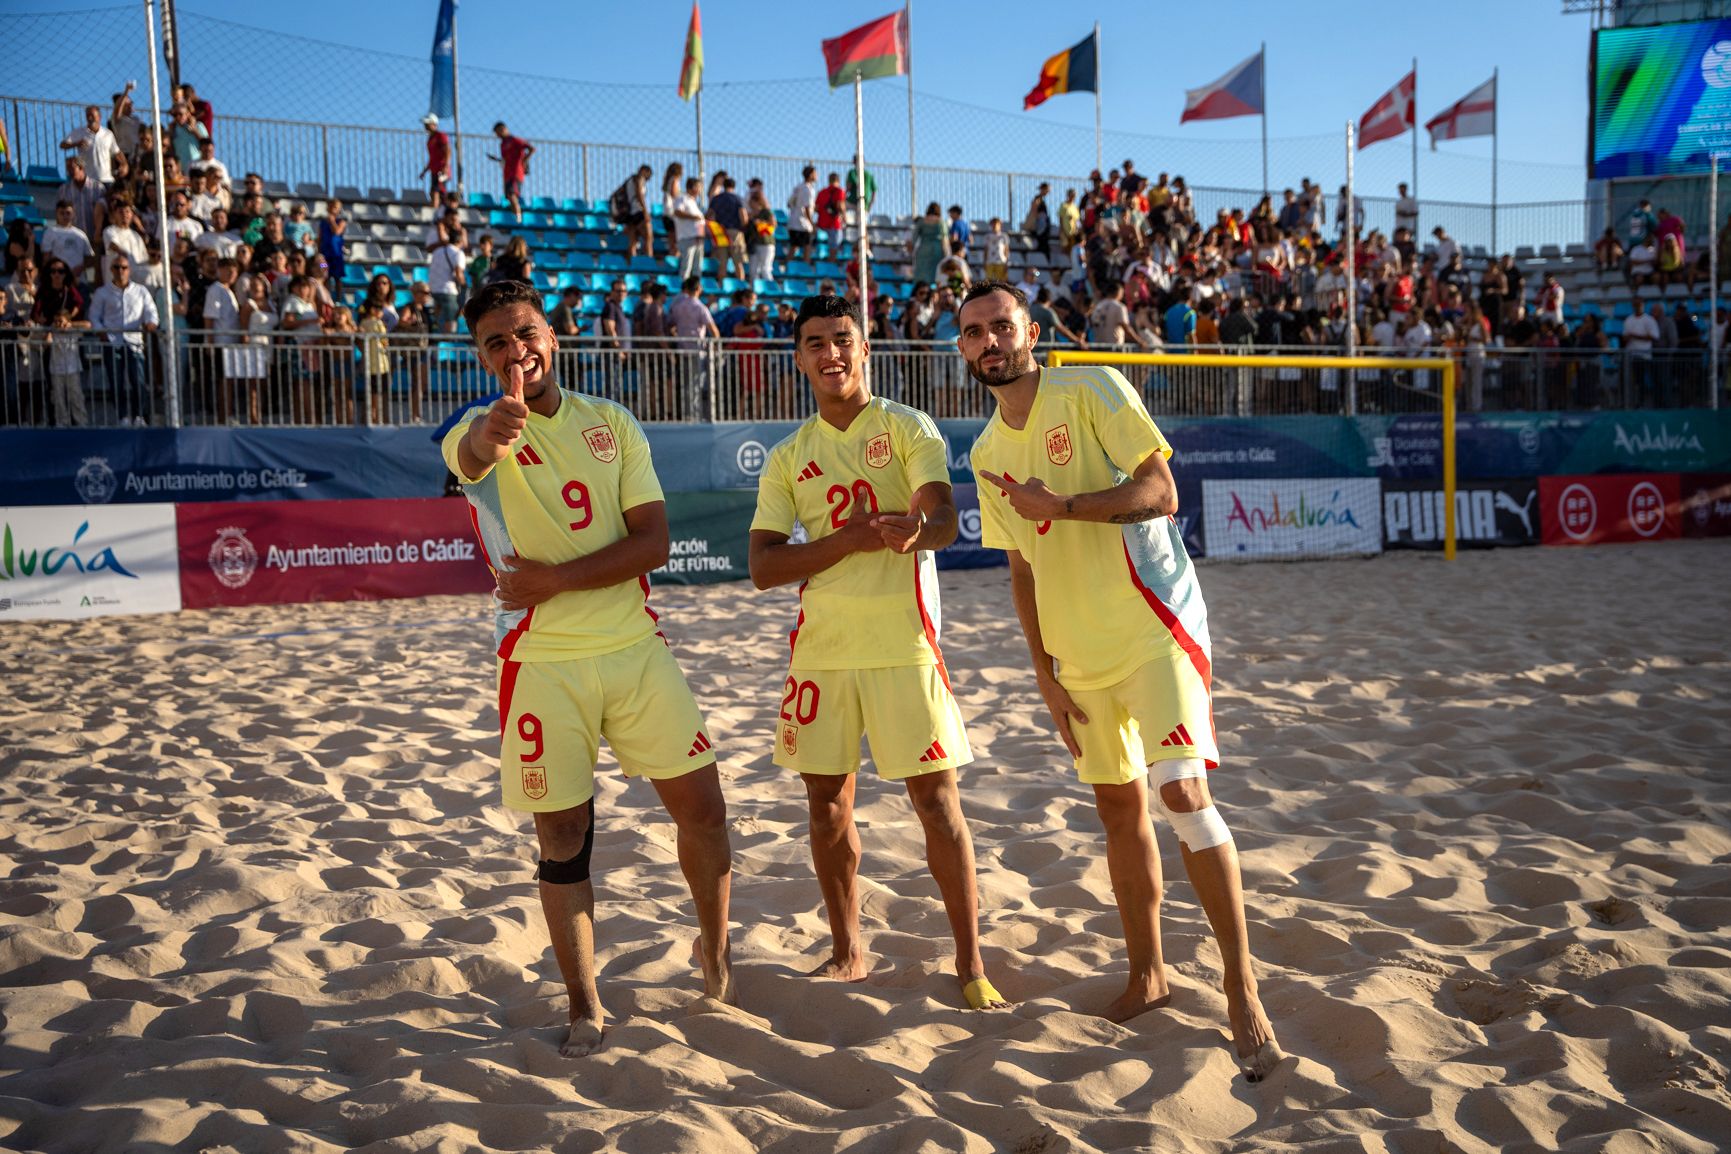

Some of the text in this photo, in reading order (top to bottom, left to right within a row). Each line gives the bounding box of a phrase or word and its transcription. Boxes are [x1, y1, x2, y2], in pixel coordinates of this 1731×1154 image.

[125, 468, 307, 495] Ayuntamiento de Cádiz
[561, 480, 594, 531] 9
[1227, 490, 1363, 534] Andalucía
[1384, 490, 1497, 542] PUMA
[0, 520, 140, 580] lucía
[265, 538, 475, 573] Ayuntamiento de Cádiz
[669, 538, 708, 555] ACIÓN
[669, 558, 685, 573] DE
[687, 555, 734, 572] FÚTBOL
[780, 675, 820, 725] 20
[517, 712, 544, 762] 9
